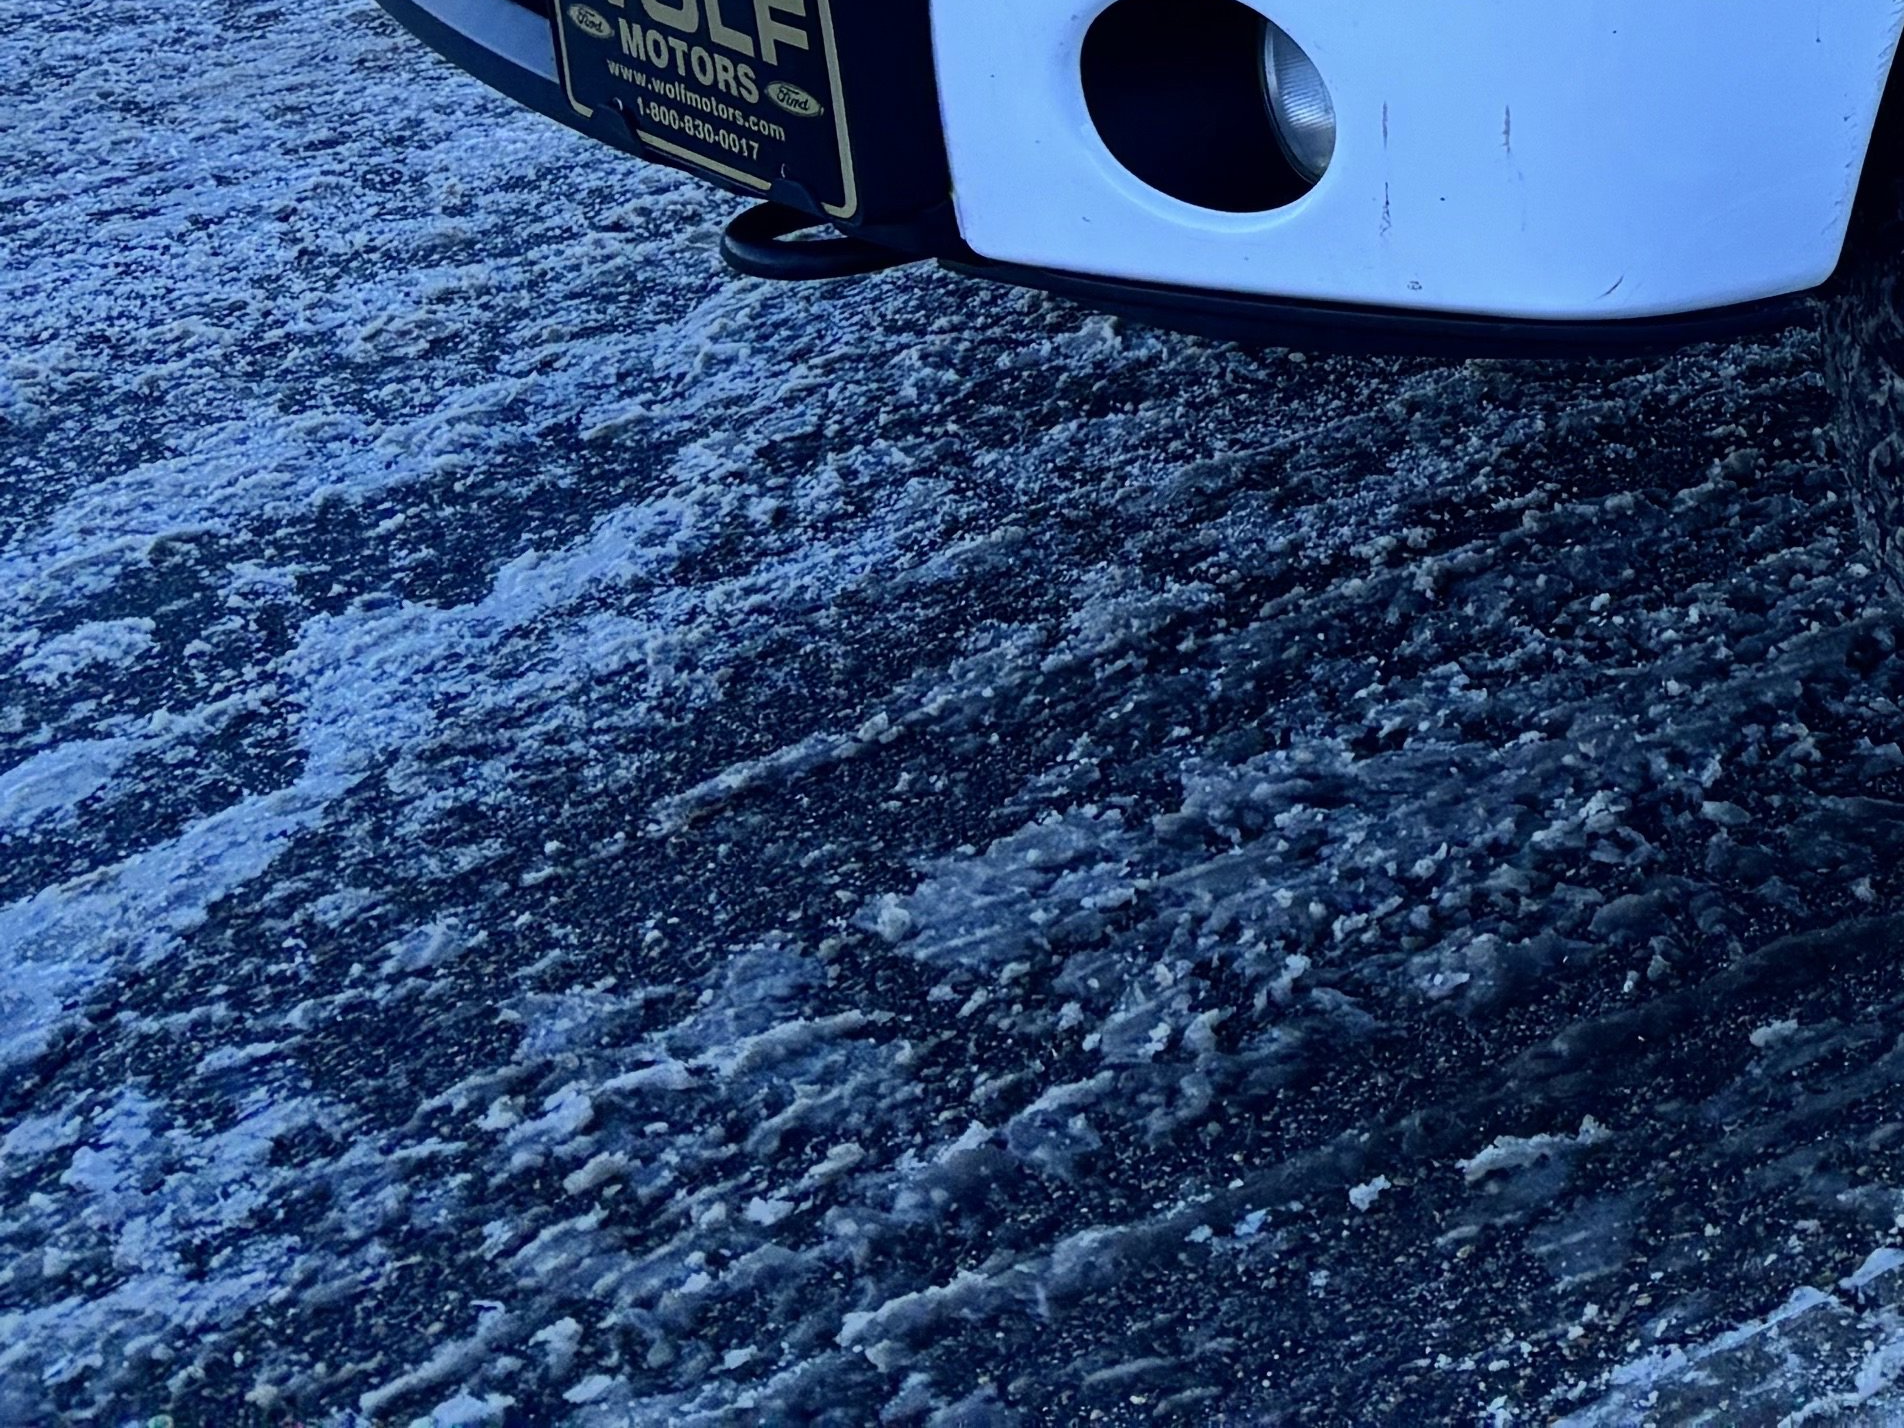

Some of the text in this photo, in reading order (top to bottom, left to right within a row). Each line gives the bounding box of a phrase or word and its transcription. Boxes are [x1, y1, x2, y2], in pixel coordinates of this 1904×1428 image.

[575, 10, 605, 34] Ford
[618, 17, 760, 104] MOTORS
[606, 59, 787, 142] www.wolfmotors.com
[637, 97, 760, 161] 1-800-830-0017
[776, 85, 811, 112] Ford
